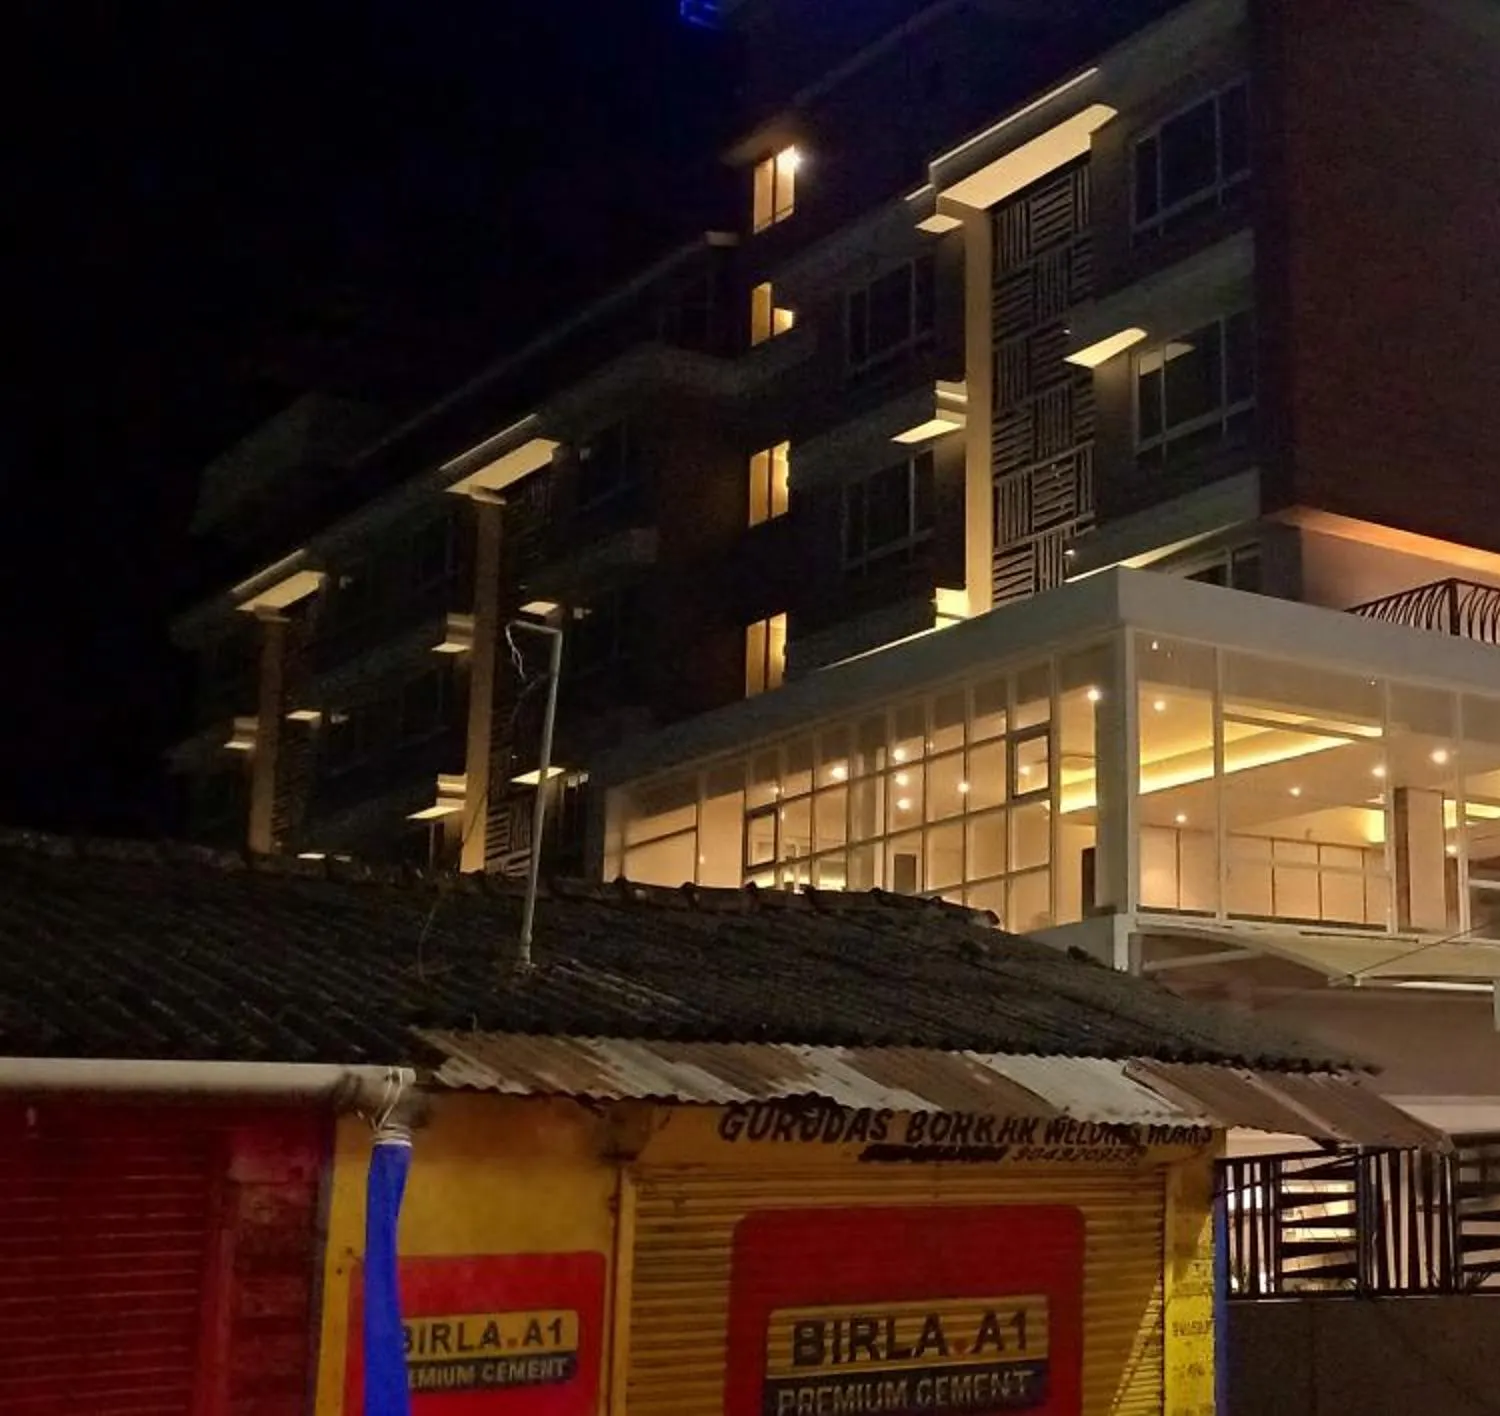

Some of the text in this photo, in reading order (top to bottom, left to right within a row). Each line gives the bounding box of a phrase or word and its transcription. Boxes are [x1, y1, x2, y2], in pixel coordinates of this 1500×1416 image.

[408, 1358, 569, 1389] EMIUM CEMENT
[777, 1370, 1034, 1416] PREMIUM CEMENT
